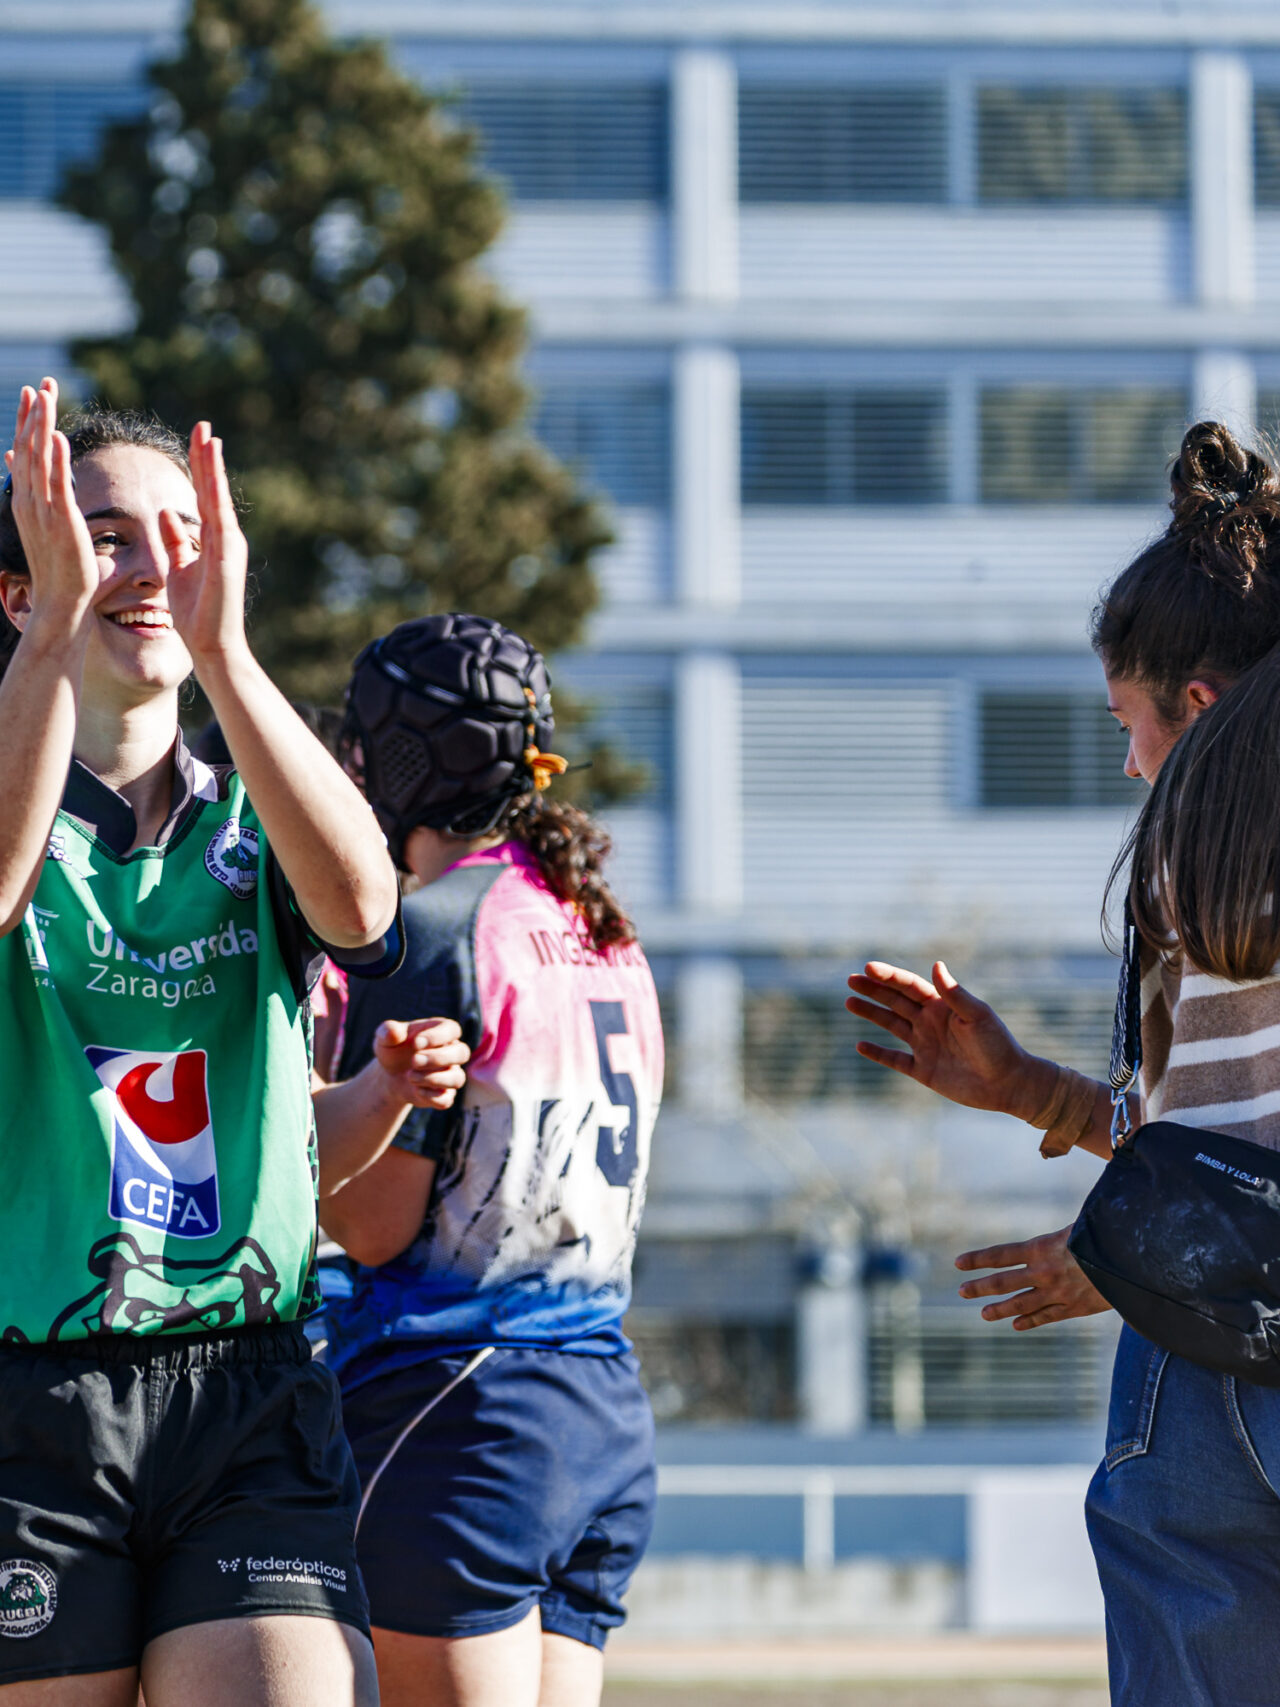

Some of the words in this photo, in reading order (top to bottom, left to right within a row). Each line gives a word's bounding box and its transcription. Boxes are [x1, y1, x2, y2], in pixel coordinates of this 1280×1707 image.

[86, 962, 217, 1008] Zaragoza
[588, 1000, 640, 1187] 5
[1195, 1152, 1227, 1171] BIMBA
[1227, 1165, 1236, 1175] Y
[1233, 1169, 1259, 1186] LOLA
[122, 1177, 210, 1229] CEFA
[246, 1556, 347, 1581] federópticos
[247, 1573, 284, 1583] Centro
[284, 1573, 323, 1586] Análisis
[322, 1578, 347, 1593] Visual
